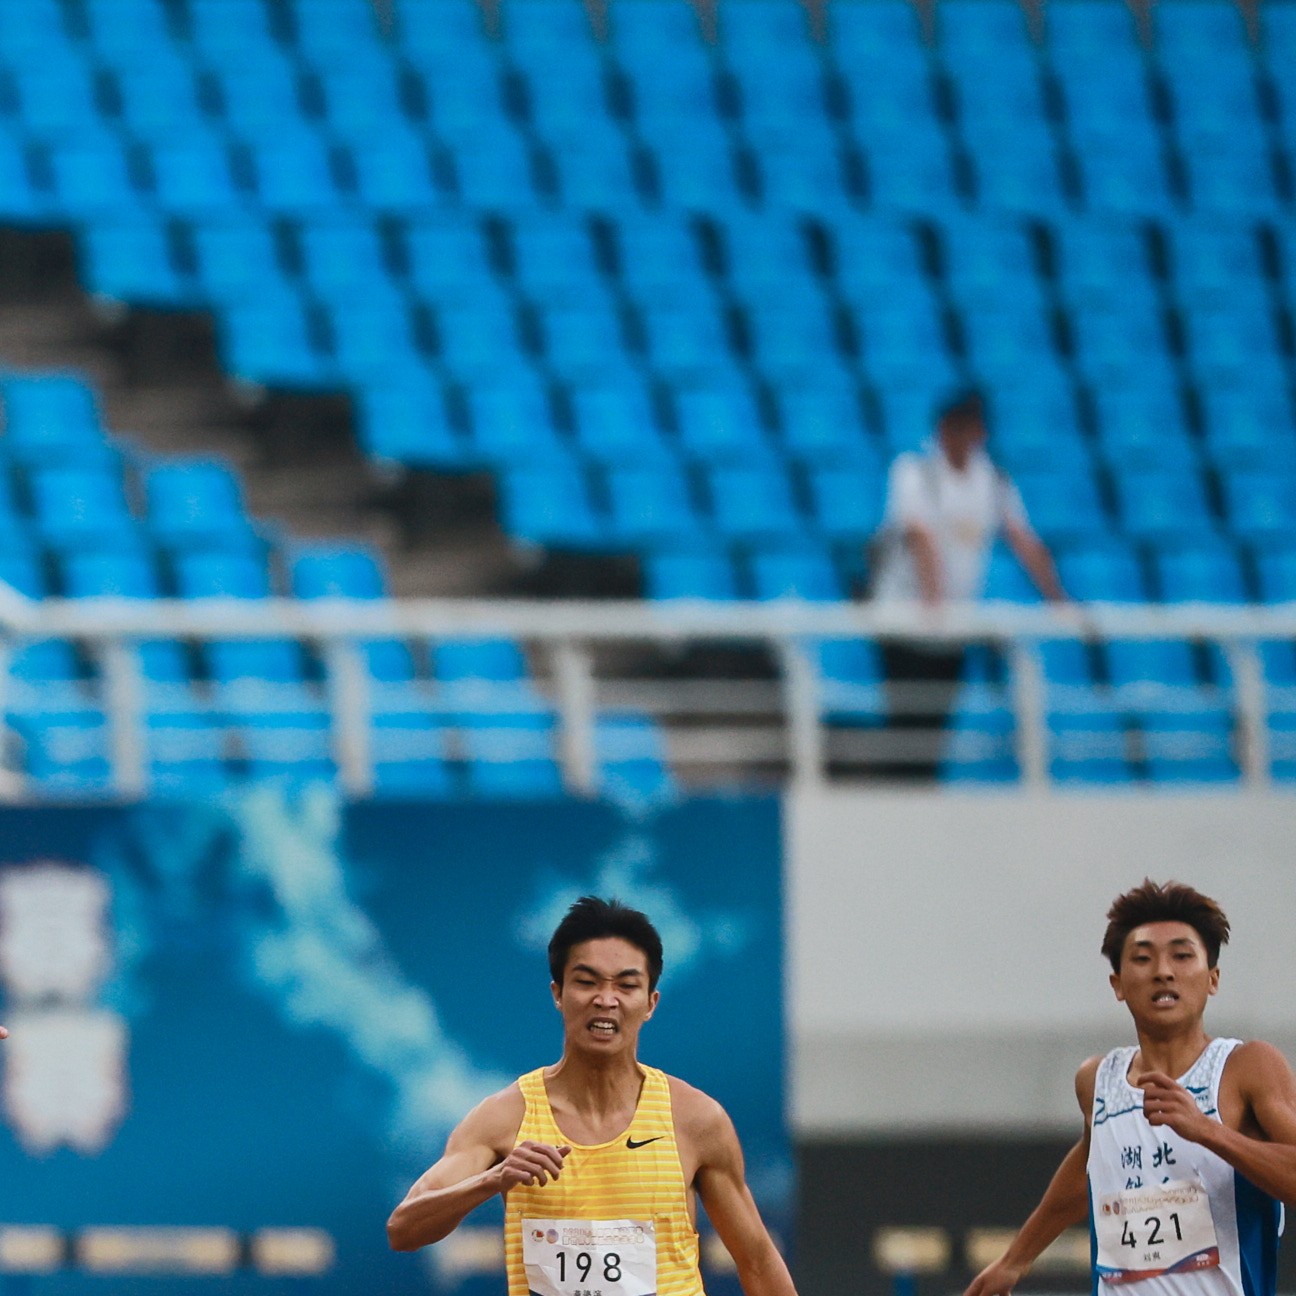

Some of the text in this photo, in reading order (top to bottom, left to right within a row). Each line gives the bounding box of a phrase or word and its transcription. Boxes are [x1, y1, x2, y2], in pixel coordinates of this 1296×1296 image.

[1121, 1141, 1176, 1169] 湖北
[1121, 1213, 1182, 1248] 421
[556, 1251, 622, 1283] 198
